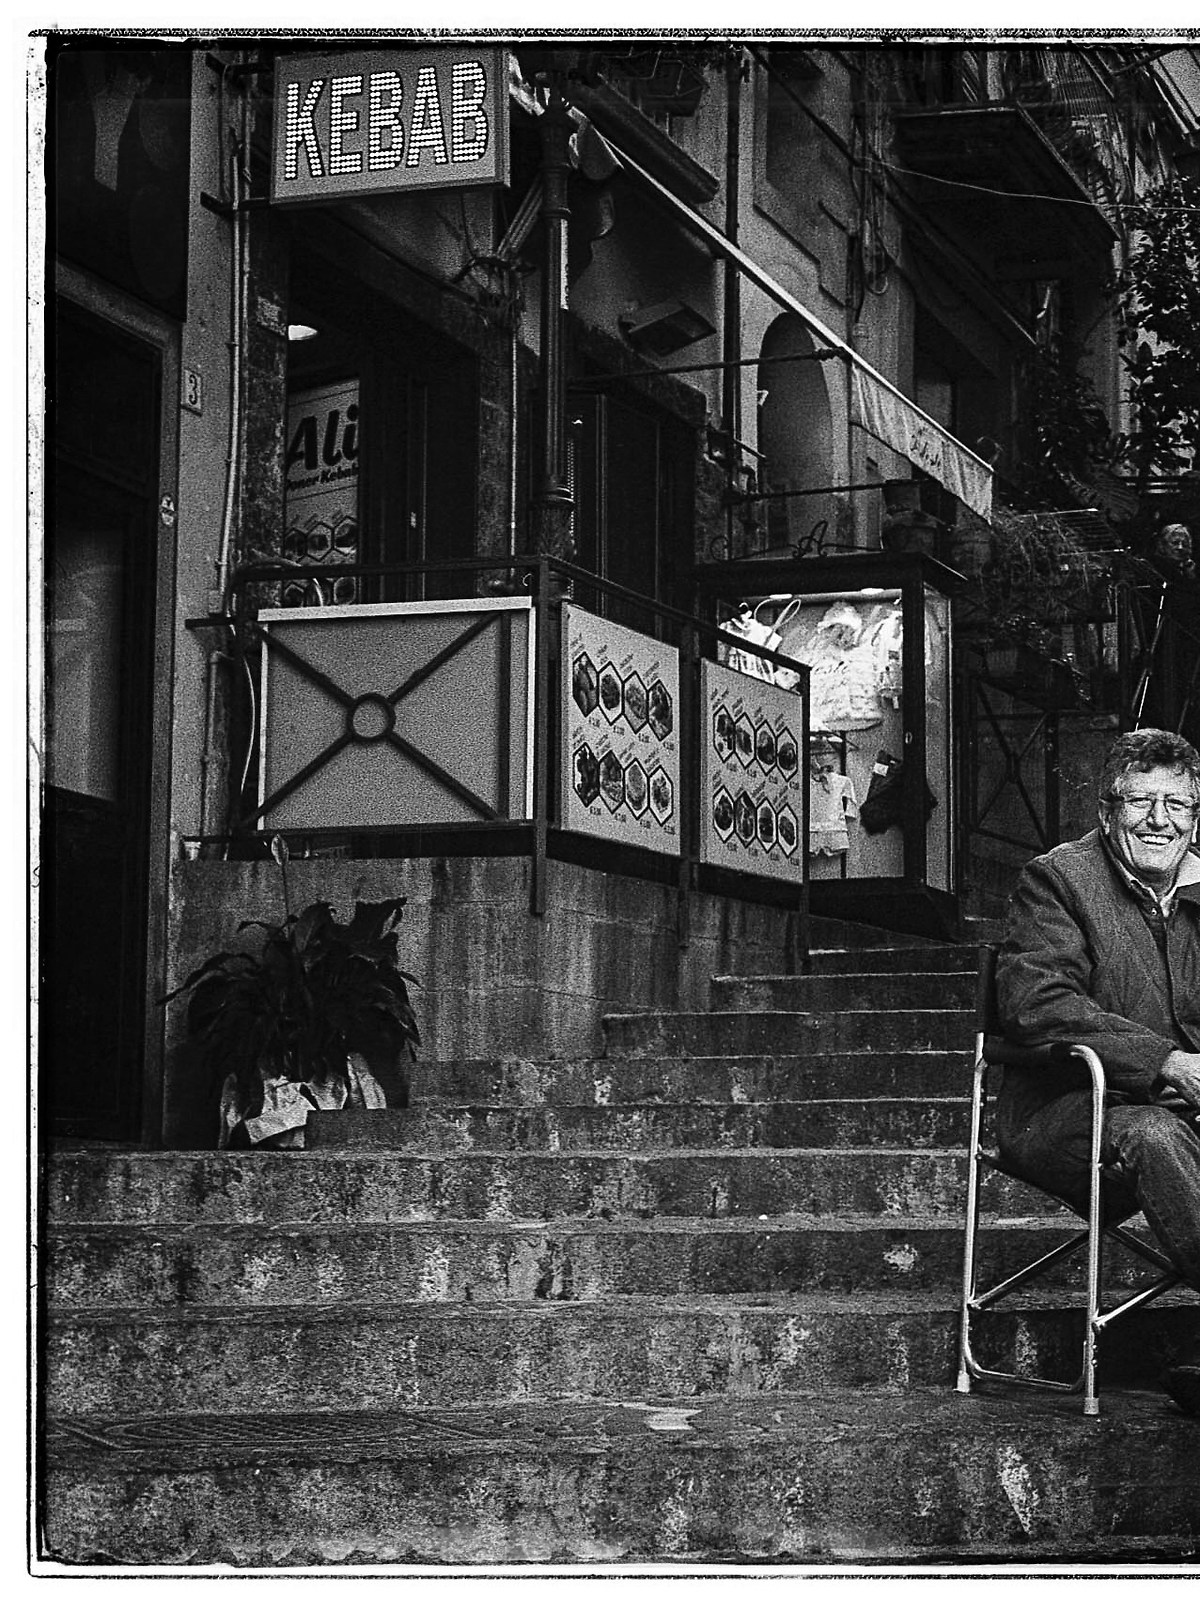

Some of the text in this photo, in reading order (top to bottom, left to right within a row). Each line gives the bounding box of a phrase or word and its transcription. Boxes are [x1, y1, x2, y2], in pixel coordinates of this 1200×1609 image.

[284, 60, 489, 181] KEBAB
[189, 374, 198, 406] 3
[285, 403, 359, 470] Ali
